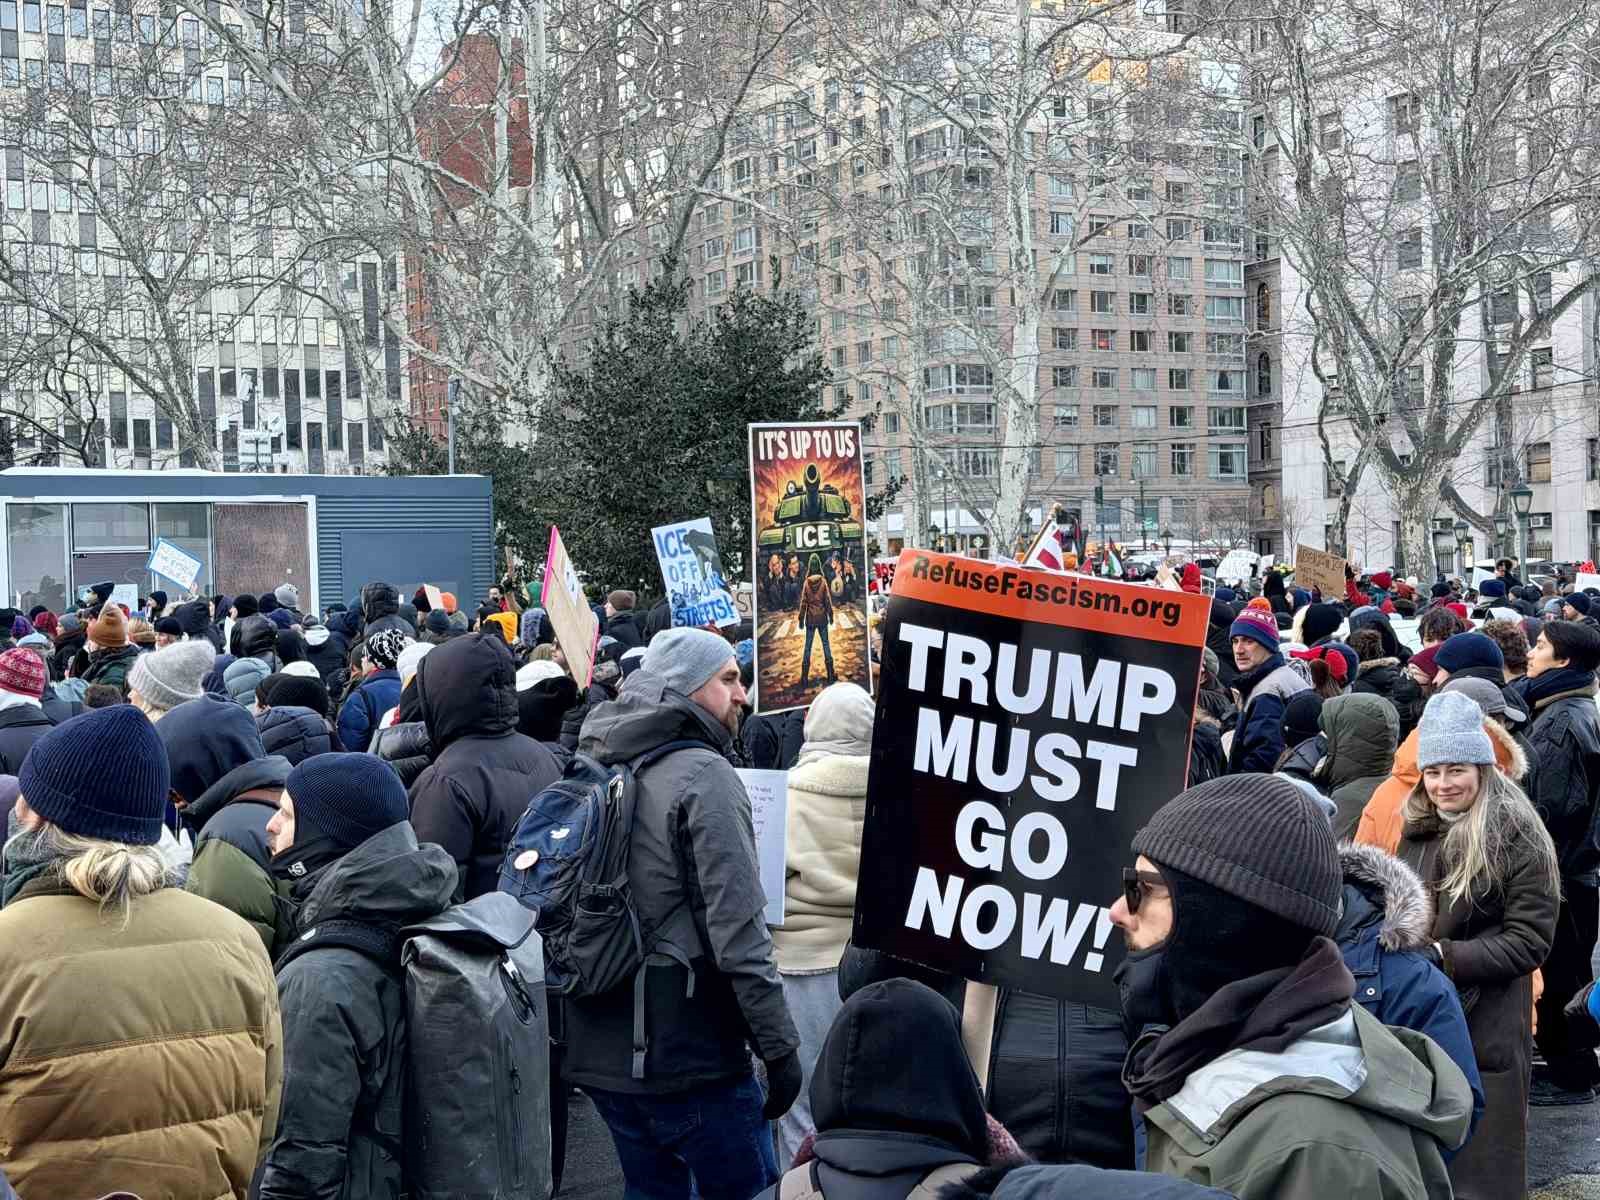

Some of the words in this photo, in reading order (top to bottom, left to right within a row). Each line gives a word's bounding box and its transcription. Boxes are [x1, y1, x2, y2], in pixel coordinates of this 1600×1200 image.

[758, 430, 788, 460] IT'S
[790, 430, 812, 459] UP
[813, 429, 832, 458] TO
[834, 428, 855, 458] US
[656, 528, 691, 559] ICE
[796, 524, 831, 548] ICE
[668, 560, 697, 583] OFF
[912, 557, 1182, 626] RefuseFascism.org
[675, 594, 735, 627] STREETS!
[899, 623, 1177, 733] TRUMP
[913, 707, 1139, 811] MUST
[955, 801, 1069, 880] GO
[905, 866, 1114, 973] NOW!
